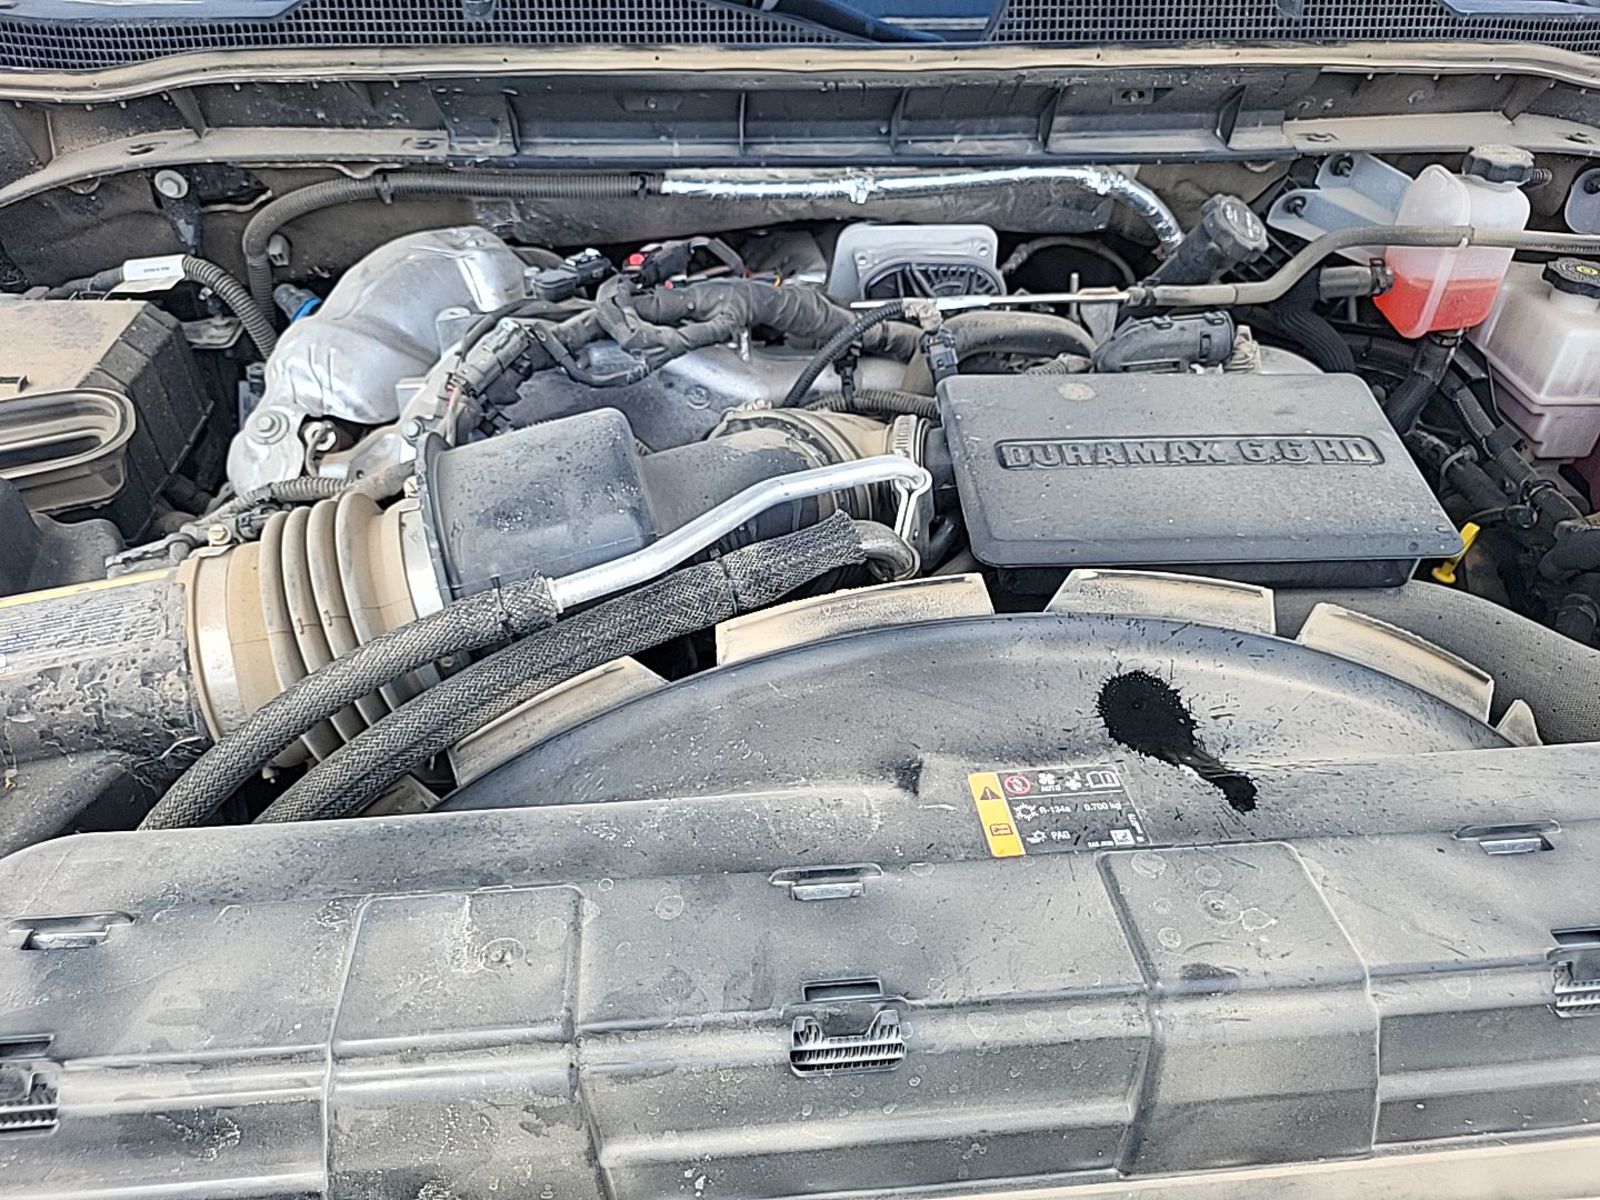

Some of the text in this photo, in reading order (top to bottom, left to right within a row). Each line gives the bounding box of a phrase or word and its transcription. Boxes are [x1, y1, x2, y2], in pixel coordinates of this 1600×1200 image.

[1003, 439, 1378, 468] DURAMAX 6.6 HD
[1039, 805, 1071, 814] R-134a
[1084, 803, 1109, 812] 0.700
[1051, 831, 1070, 840] PAG
